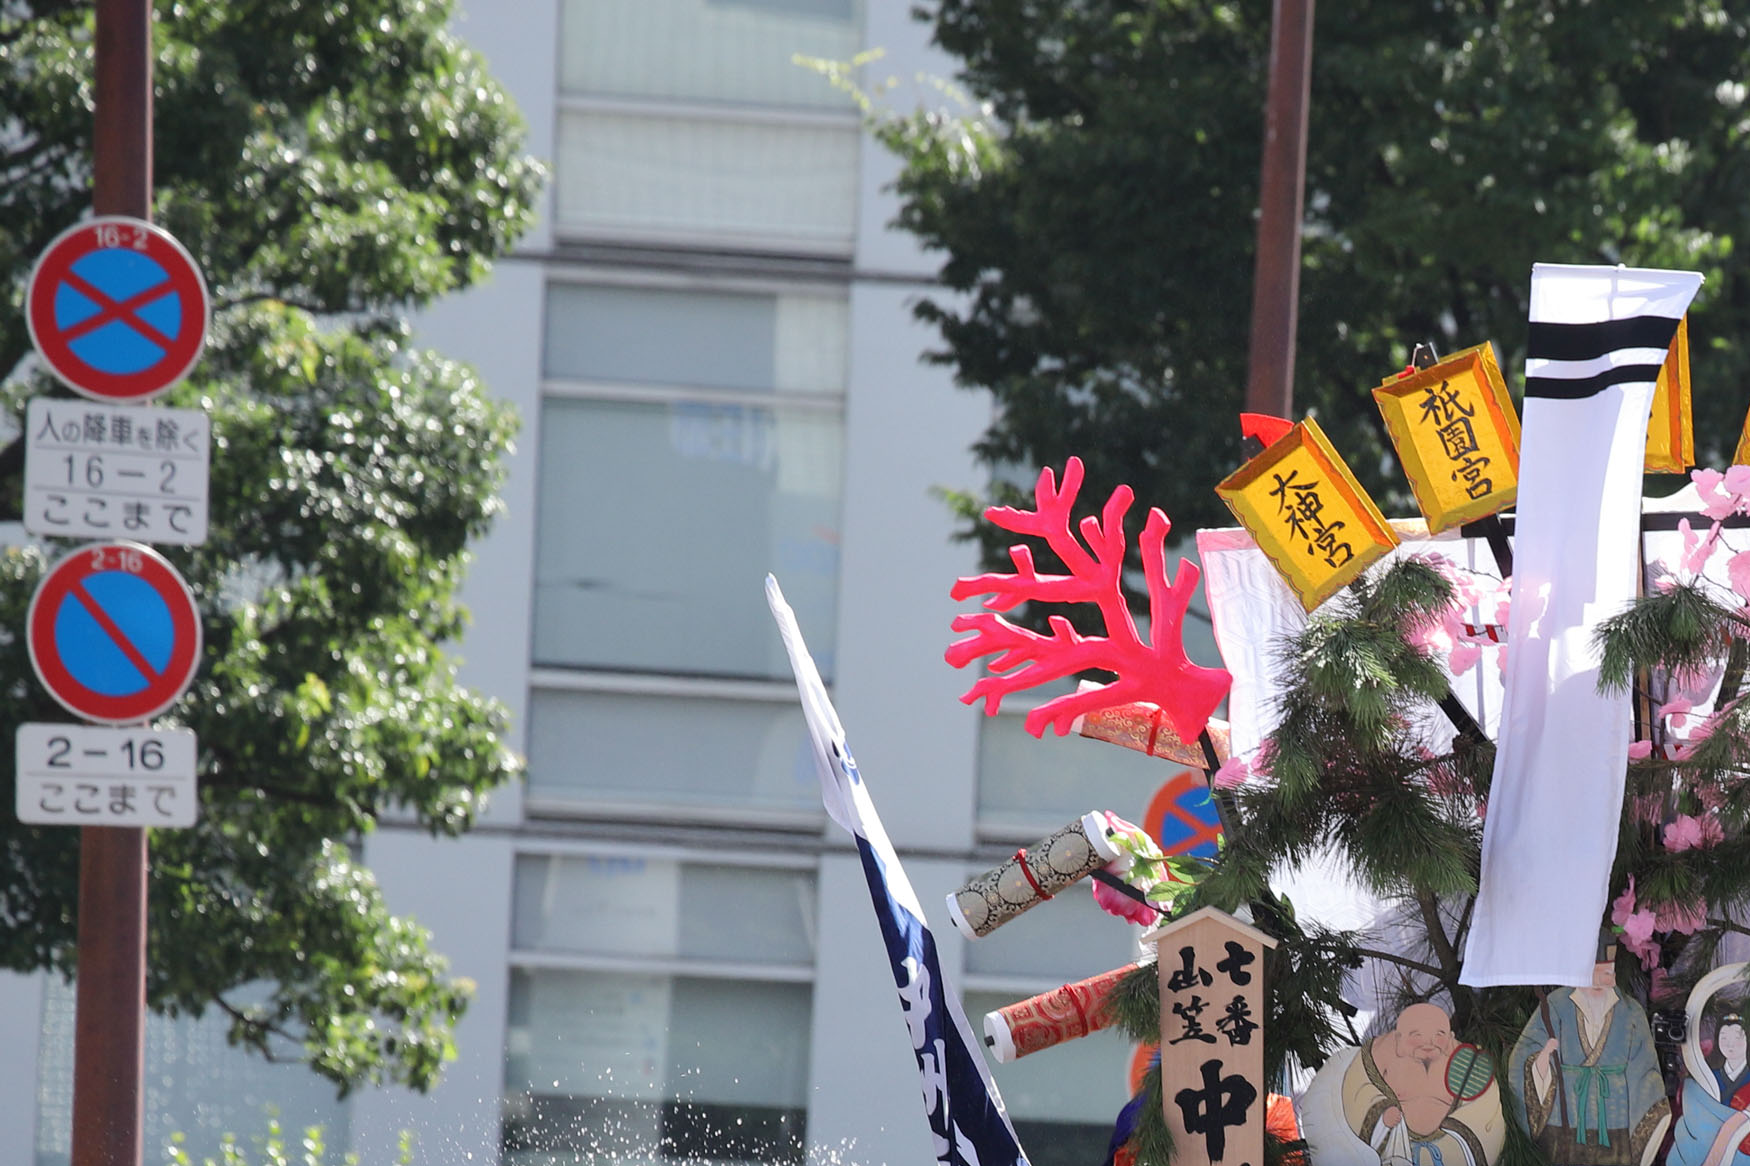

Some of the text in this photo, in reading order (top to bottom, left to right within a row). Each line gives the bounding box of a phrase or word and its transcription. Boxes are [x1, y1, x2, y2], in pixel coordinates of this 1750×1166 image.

[36, 411, 200, 452] 人の降車を除く
[43, 494, 192, 534] ここまで
[1269, 470, 1353, 569] 大神宮
[40, 783, 177, 817] ここまで
[1167, 945, 1217, 1046] 山笠
[1217, 940, 1262, 1047] 七番
